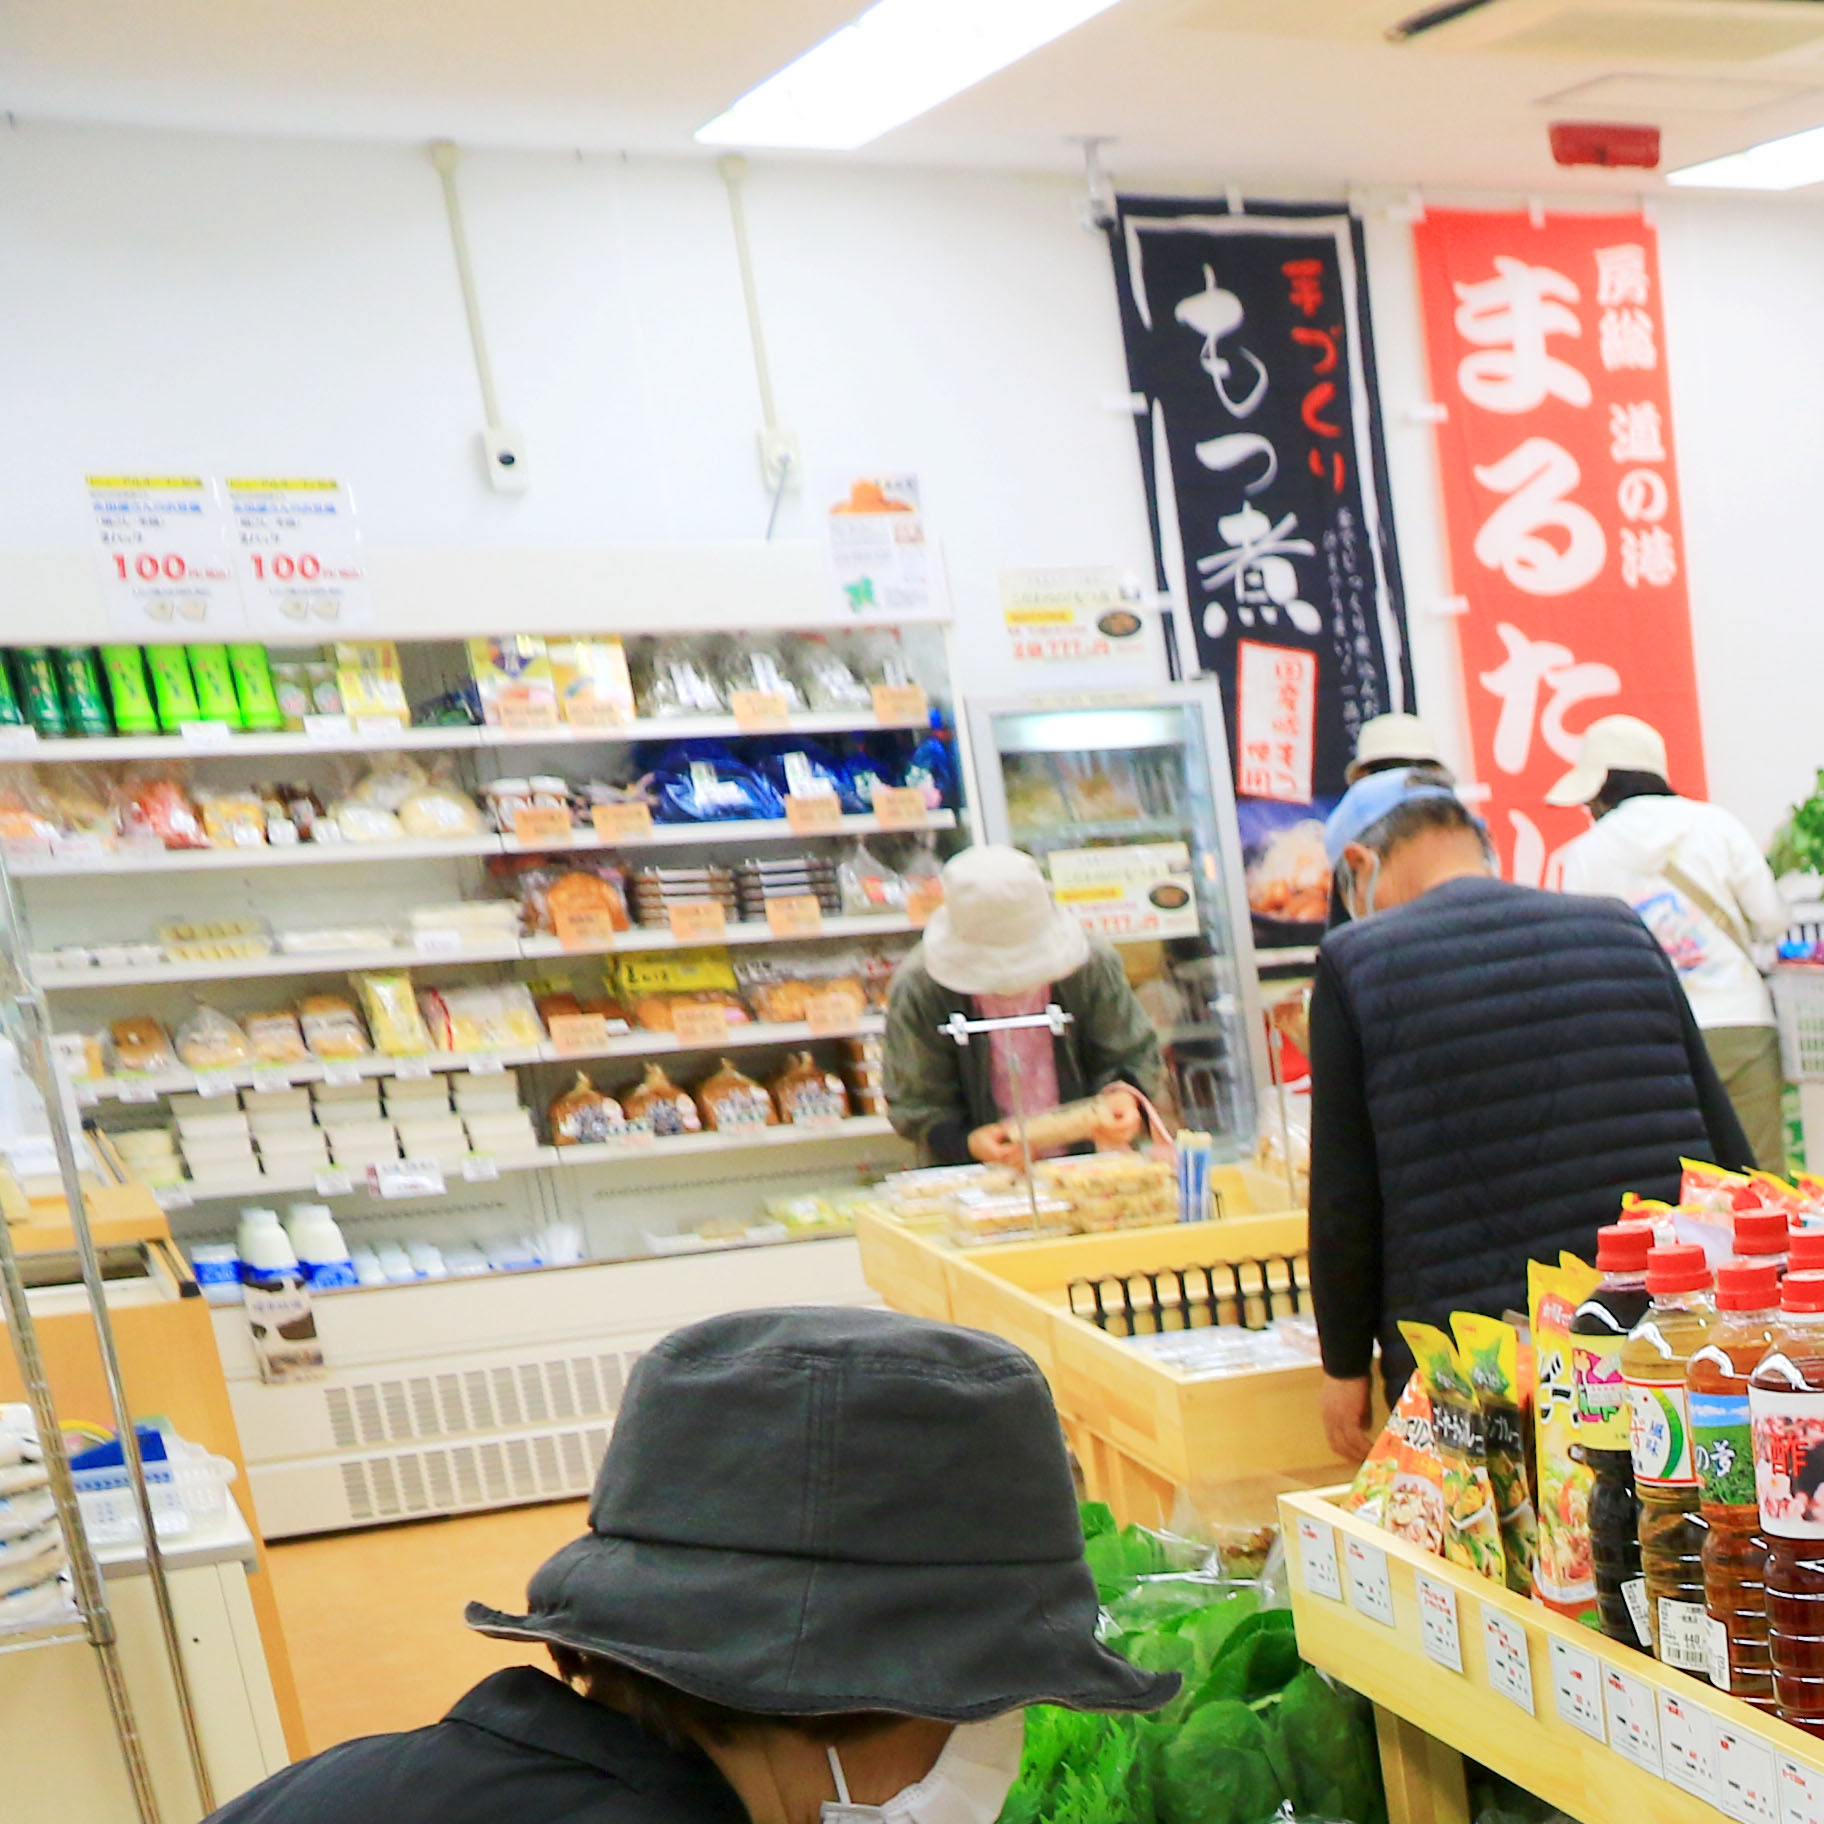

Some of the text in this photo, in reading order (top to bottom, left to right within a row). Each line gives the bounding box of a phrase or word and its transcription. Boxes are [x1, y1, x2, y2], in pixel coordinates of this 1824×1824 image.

[1596, 245, 1658, 371] 房総
[1174, 265, 1322, 636] もつ煮
[113, 553, 186, 581] 100
[251, 553, 321, 581] 100
